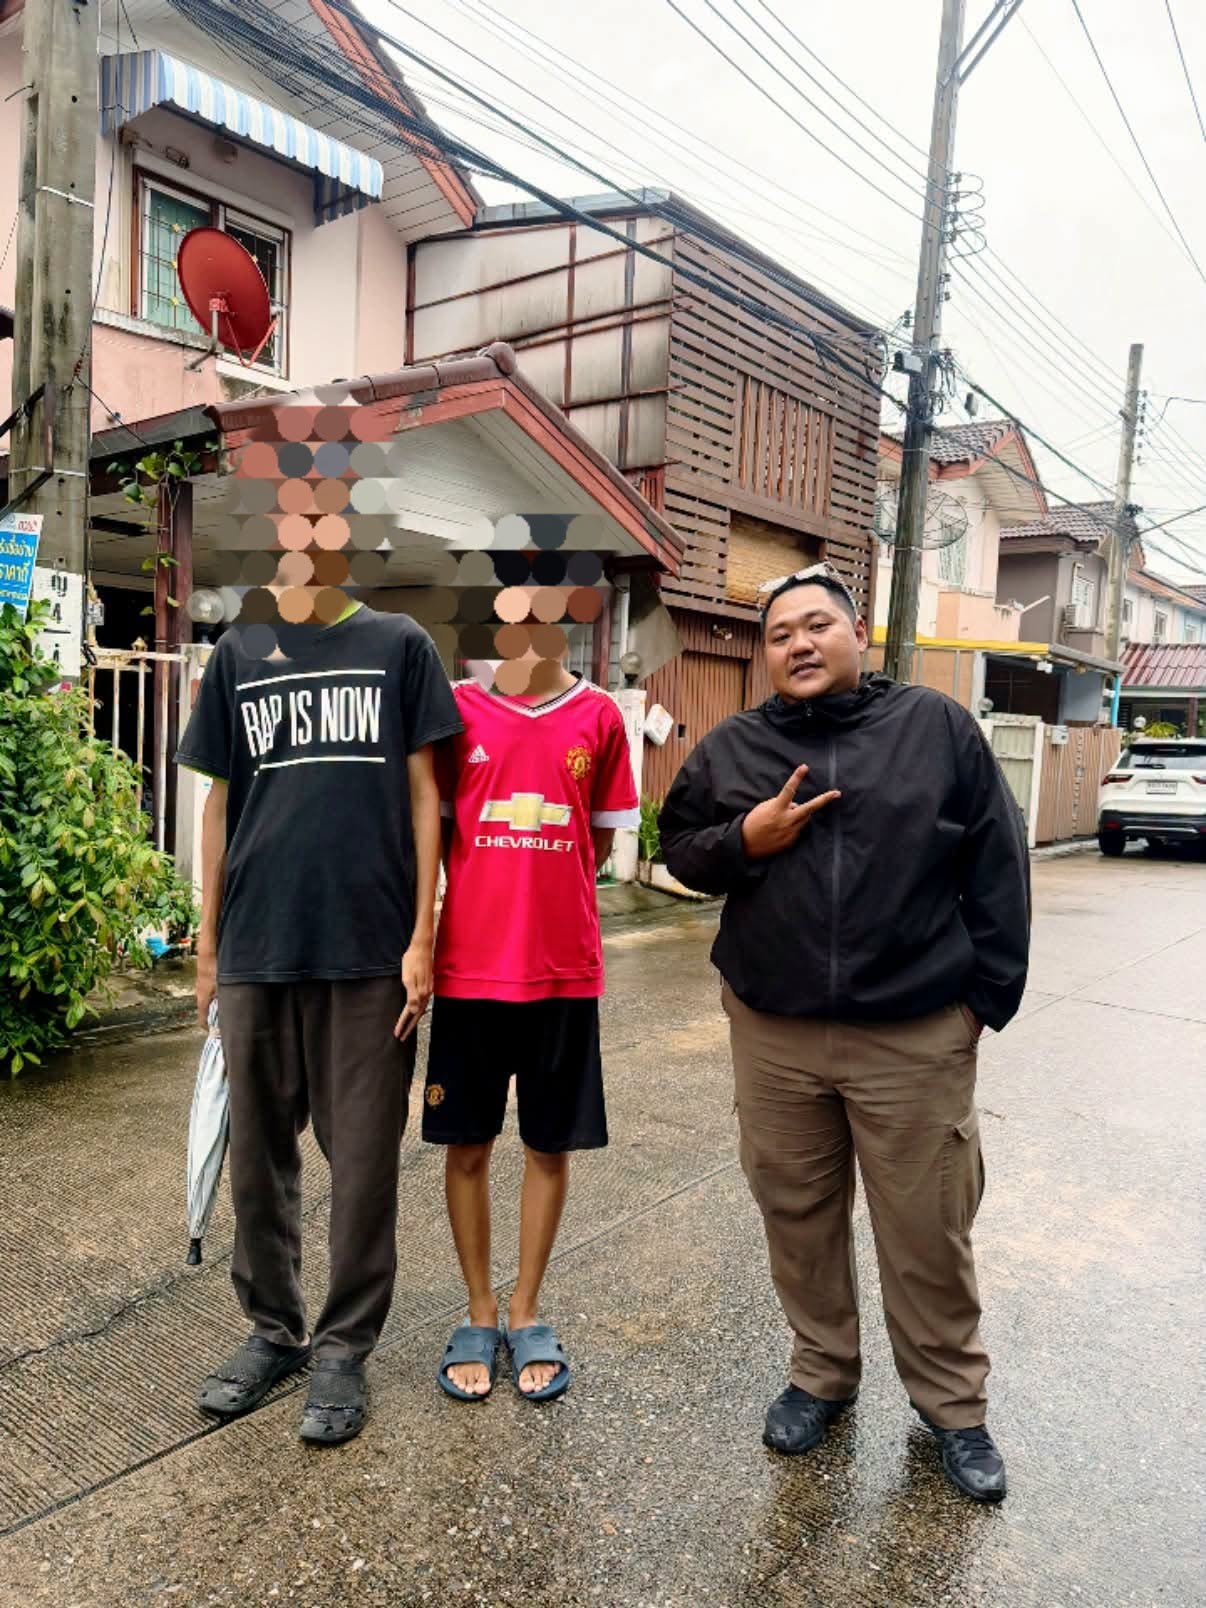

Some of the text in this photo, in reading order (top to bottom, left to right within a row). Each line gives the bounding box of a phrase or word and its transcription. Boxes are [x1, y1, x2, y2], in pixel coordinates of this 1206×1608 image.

[240, 686, 381, 758] RAP IS NOW
[474, 835, 574, 853] CHEVROLET
